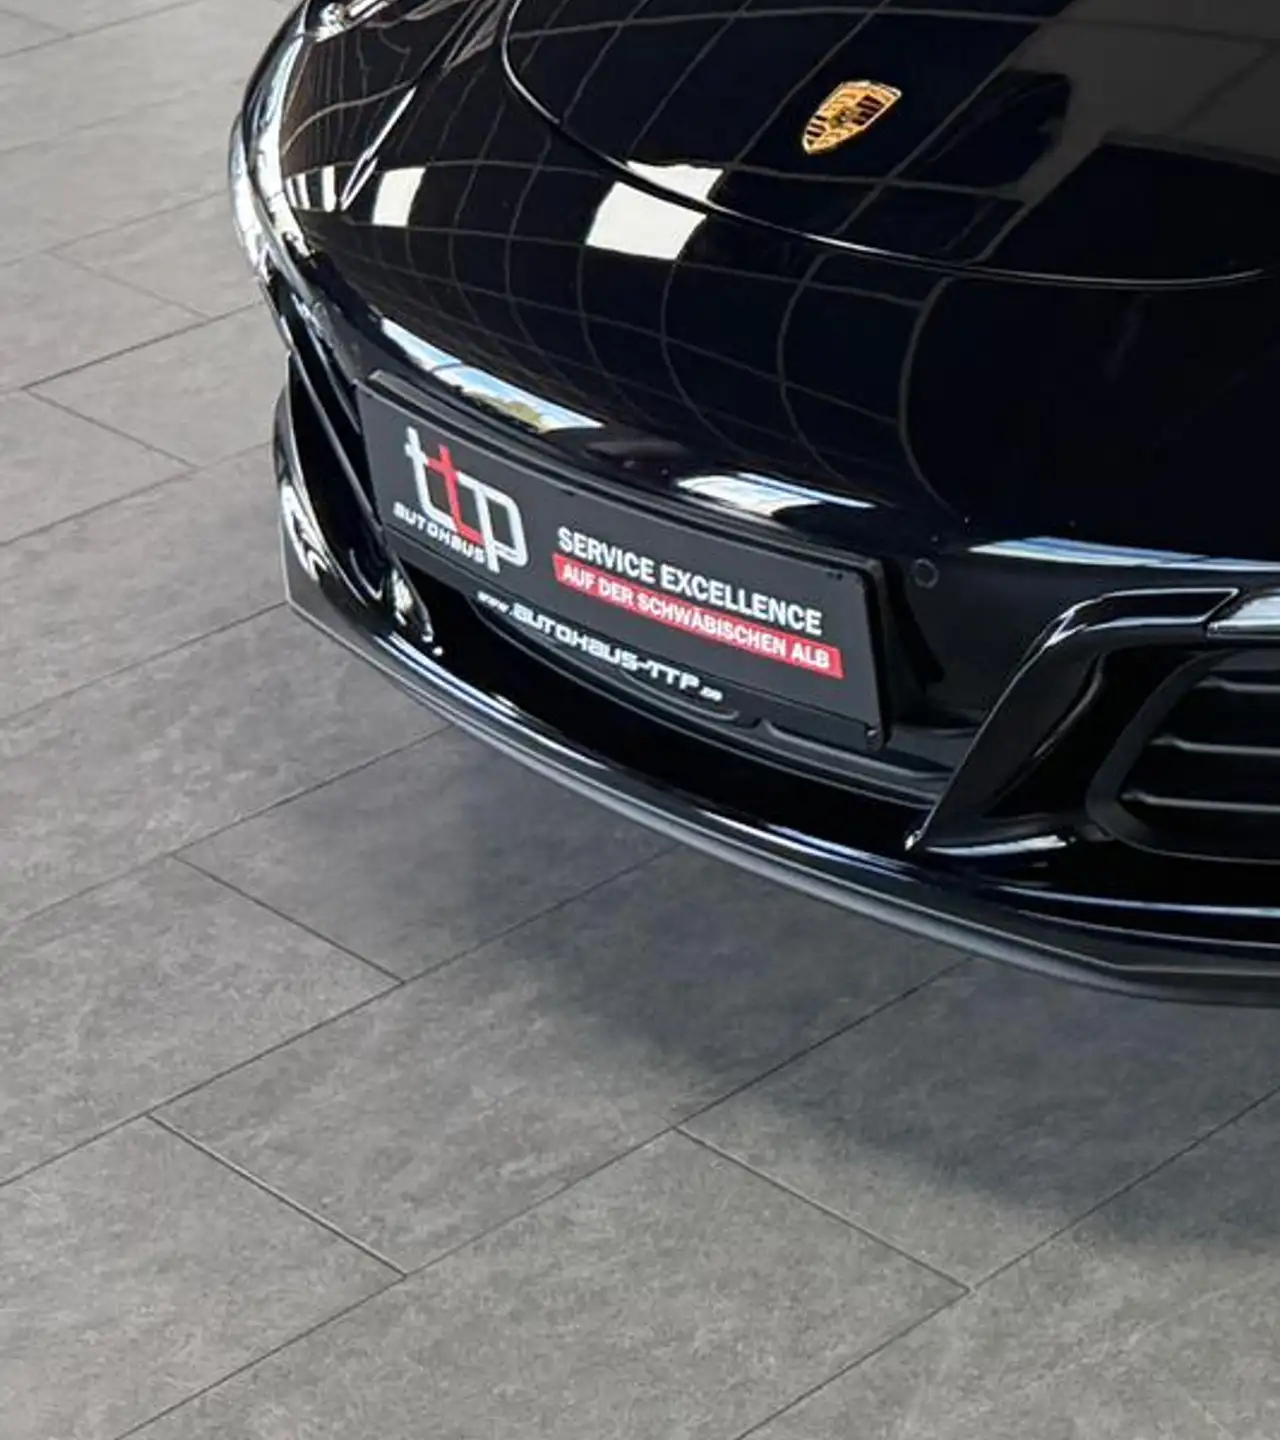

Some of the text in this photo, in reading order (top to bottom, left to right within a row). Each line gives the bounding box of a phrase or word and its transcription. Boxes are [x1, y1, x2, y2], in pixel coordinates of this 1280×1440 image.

[393, 501, 485, 563] AUTOHAUS
[404, 426, 529, 574] ttp
[557, 526, 822, 636] SERVICE EXCELLENCE
[562, 564, 595, 591] AUF
[599, 576, 633, 604] DER
[791, 648, 830, 669] ALB
